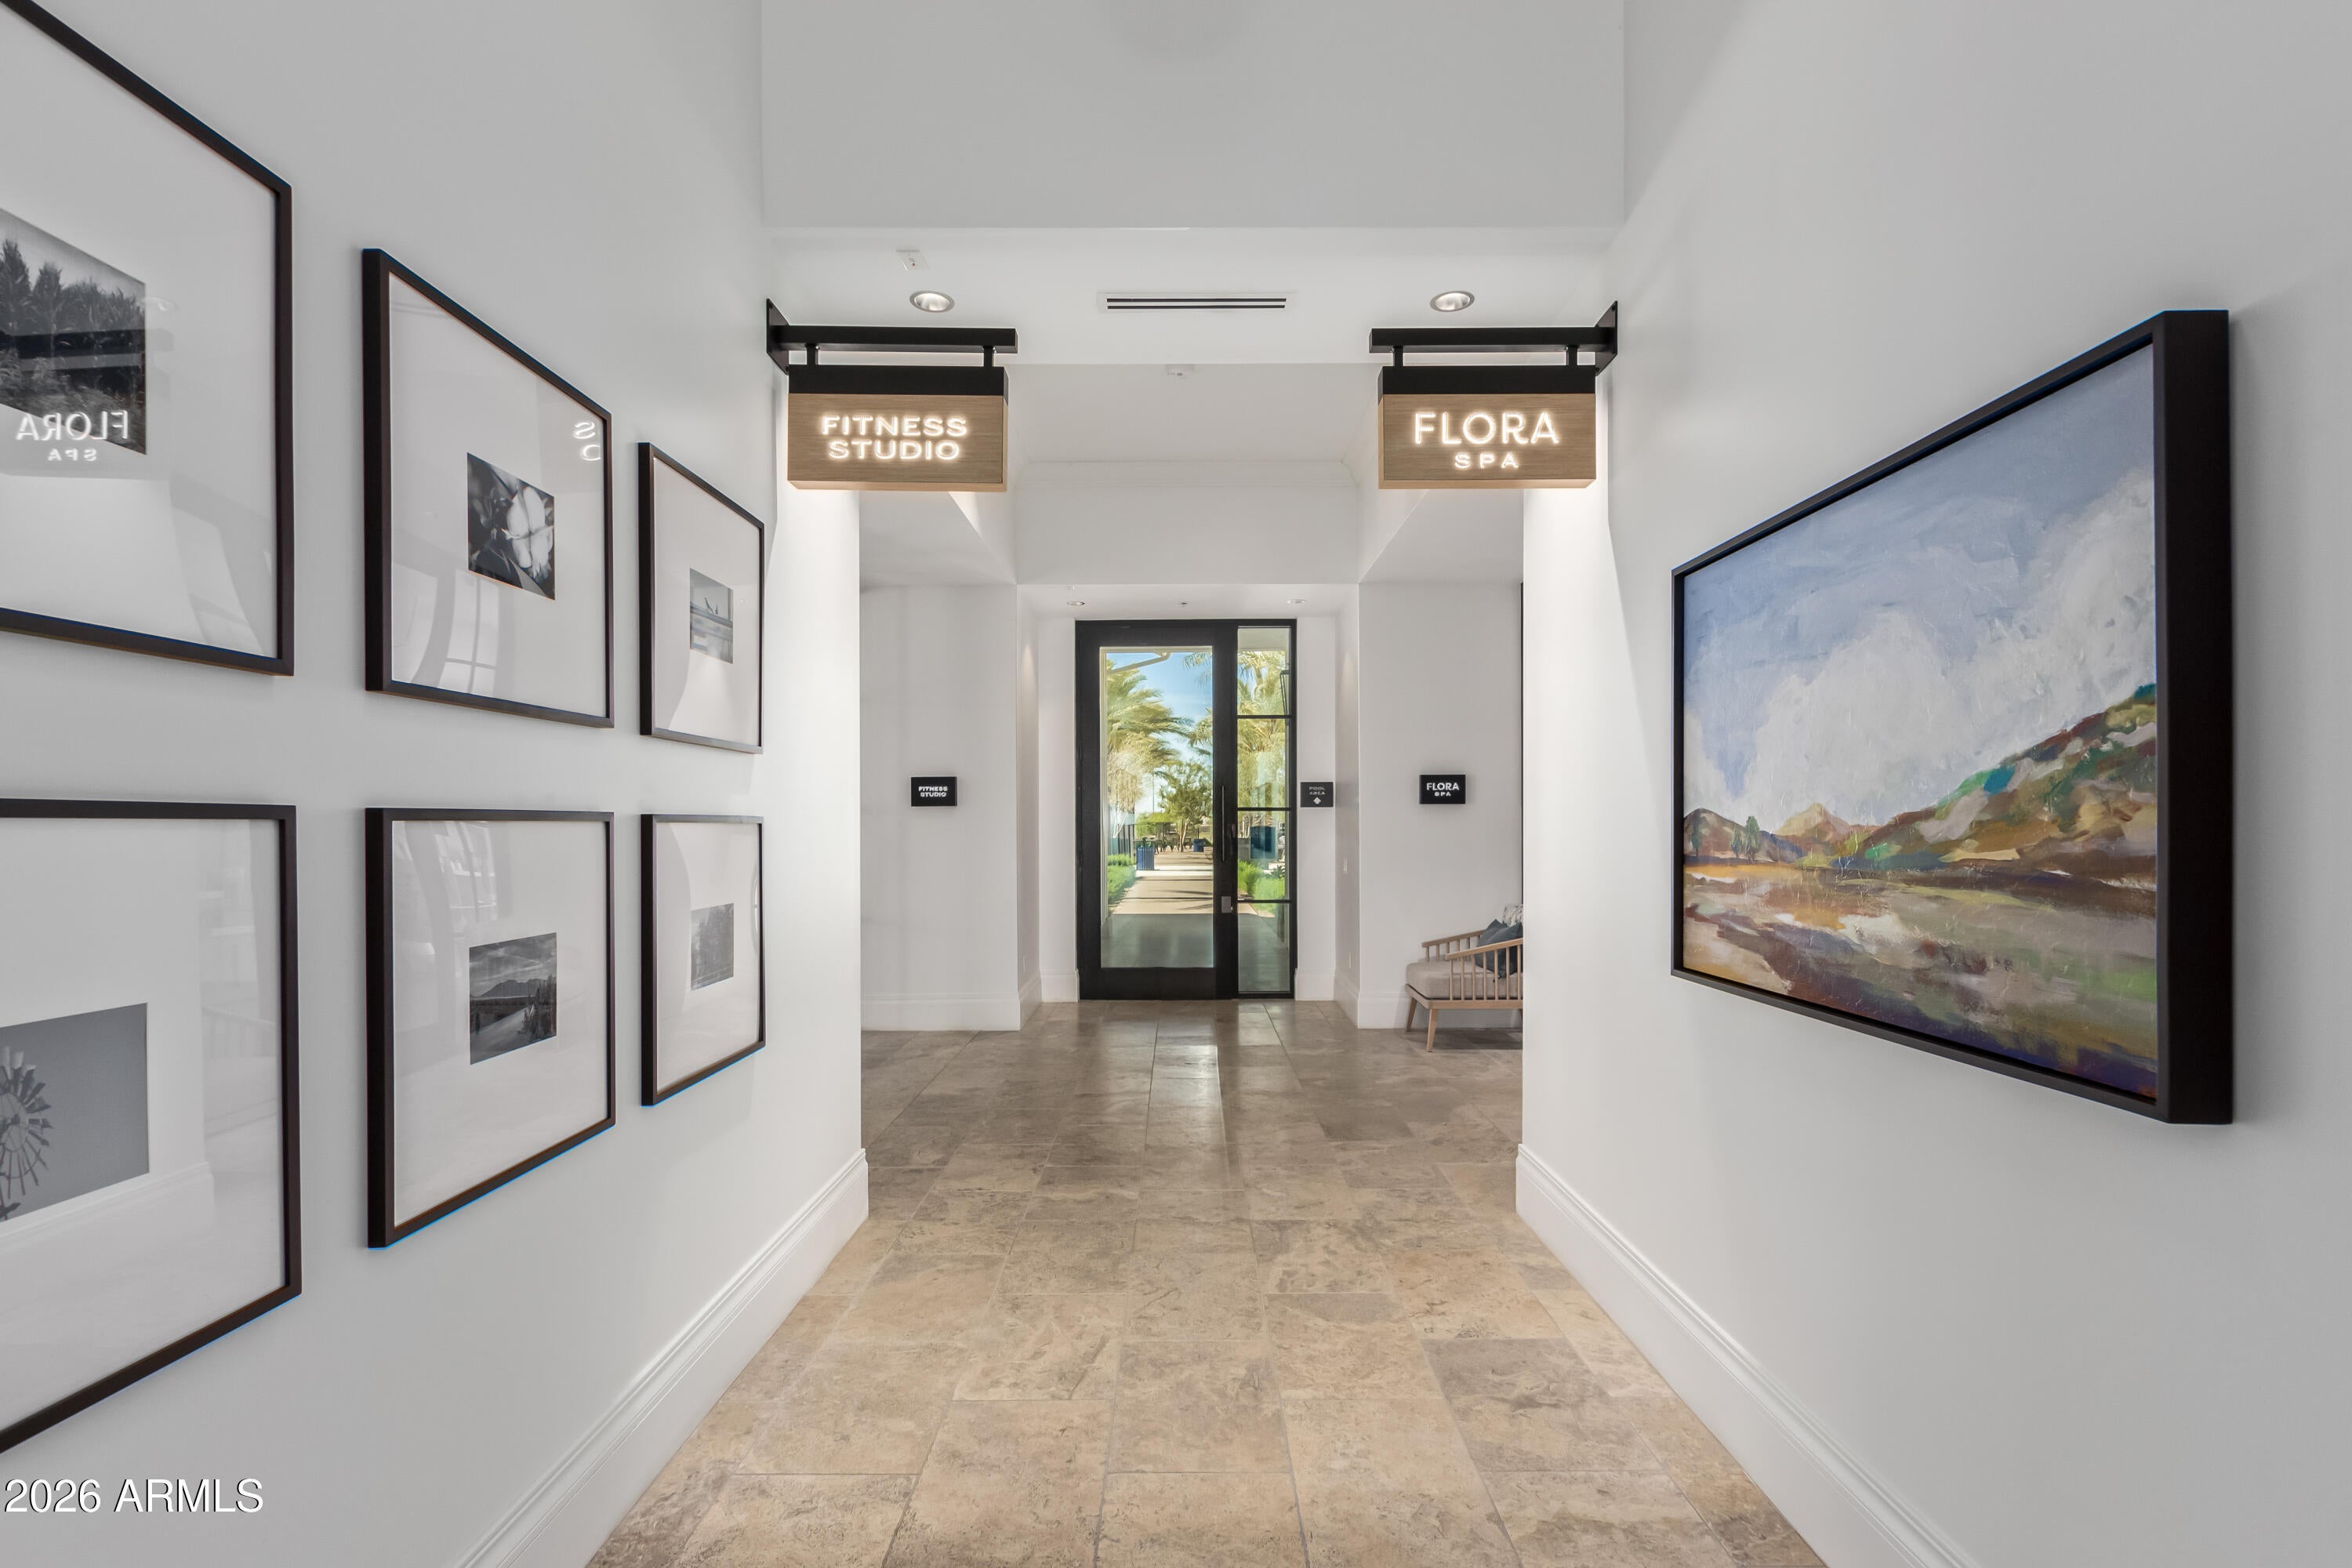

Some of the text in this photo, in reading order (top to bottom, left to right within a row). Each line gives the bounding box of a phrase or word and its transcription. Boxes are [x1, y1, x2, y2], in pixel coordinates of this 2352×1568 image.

[822, 415, 967, 437] FITNESS
[1414, 411, 1560, 445] FLORA
[828, 440, 960, 460] STUDIO
[1454, 452, 1519, 469] SPA
[1426, 782, 1460, 791] FLORA
